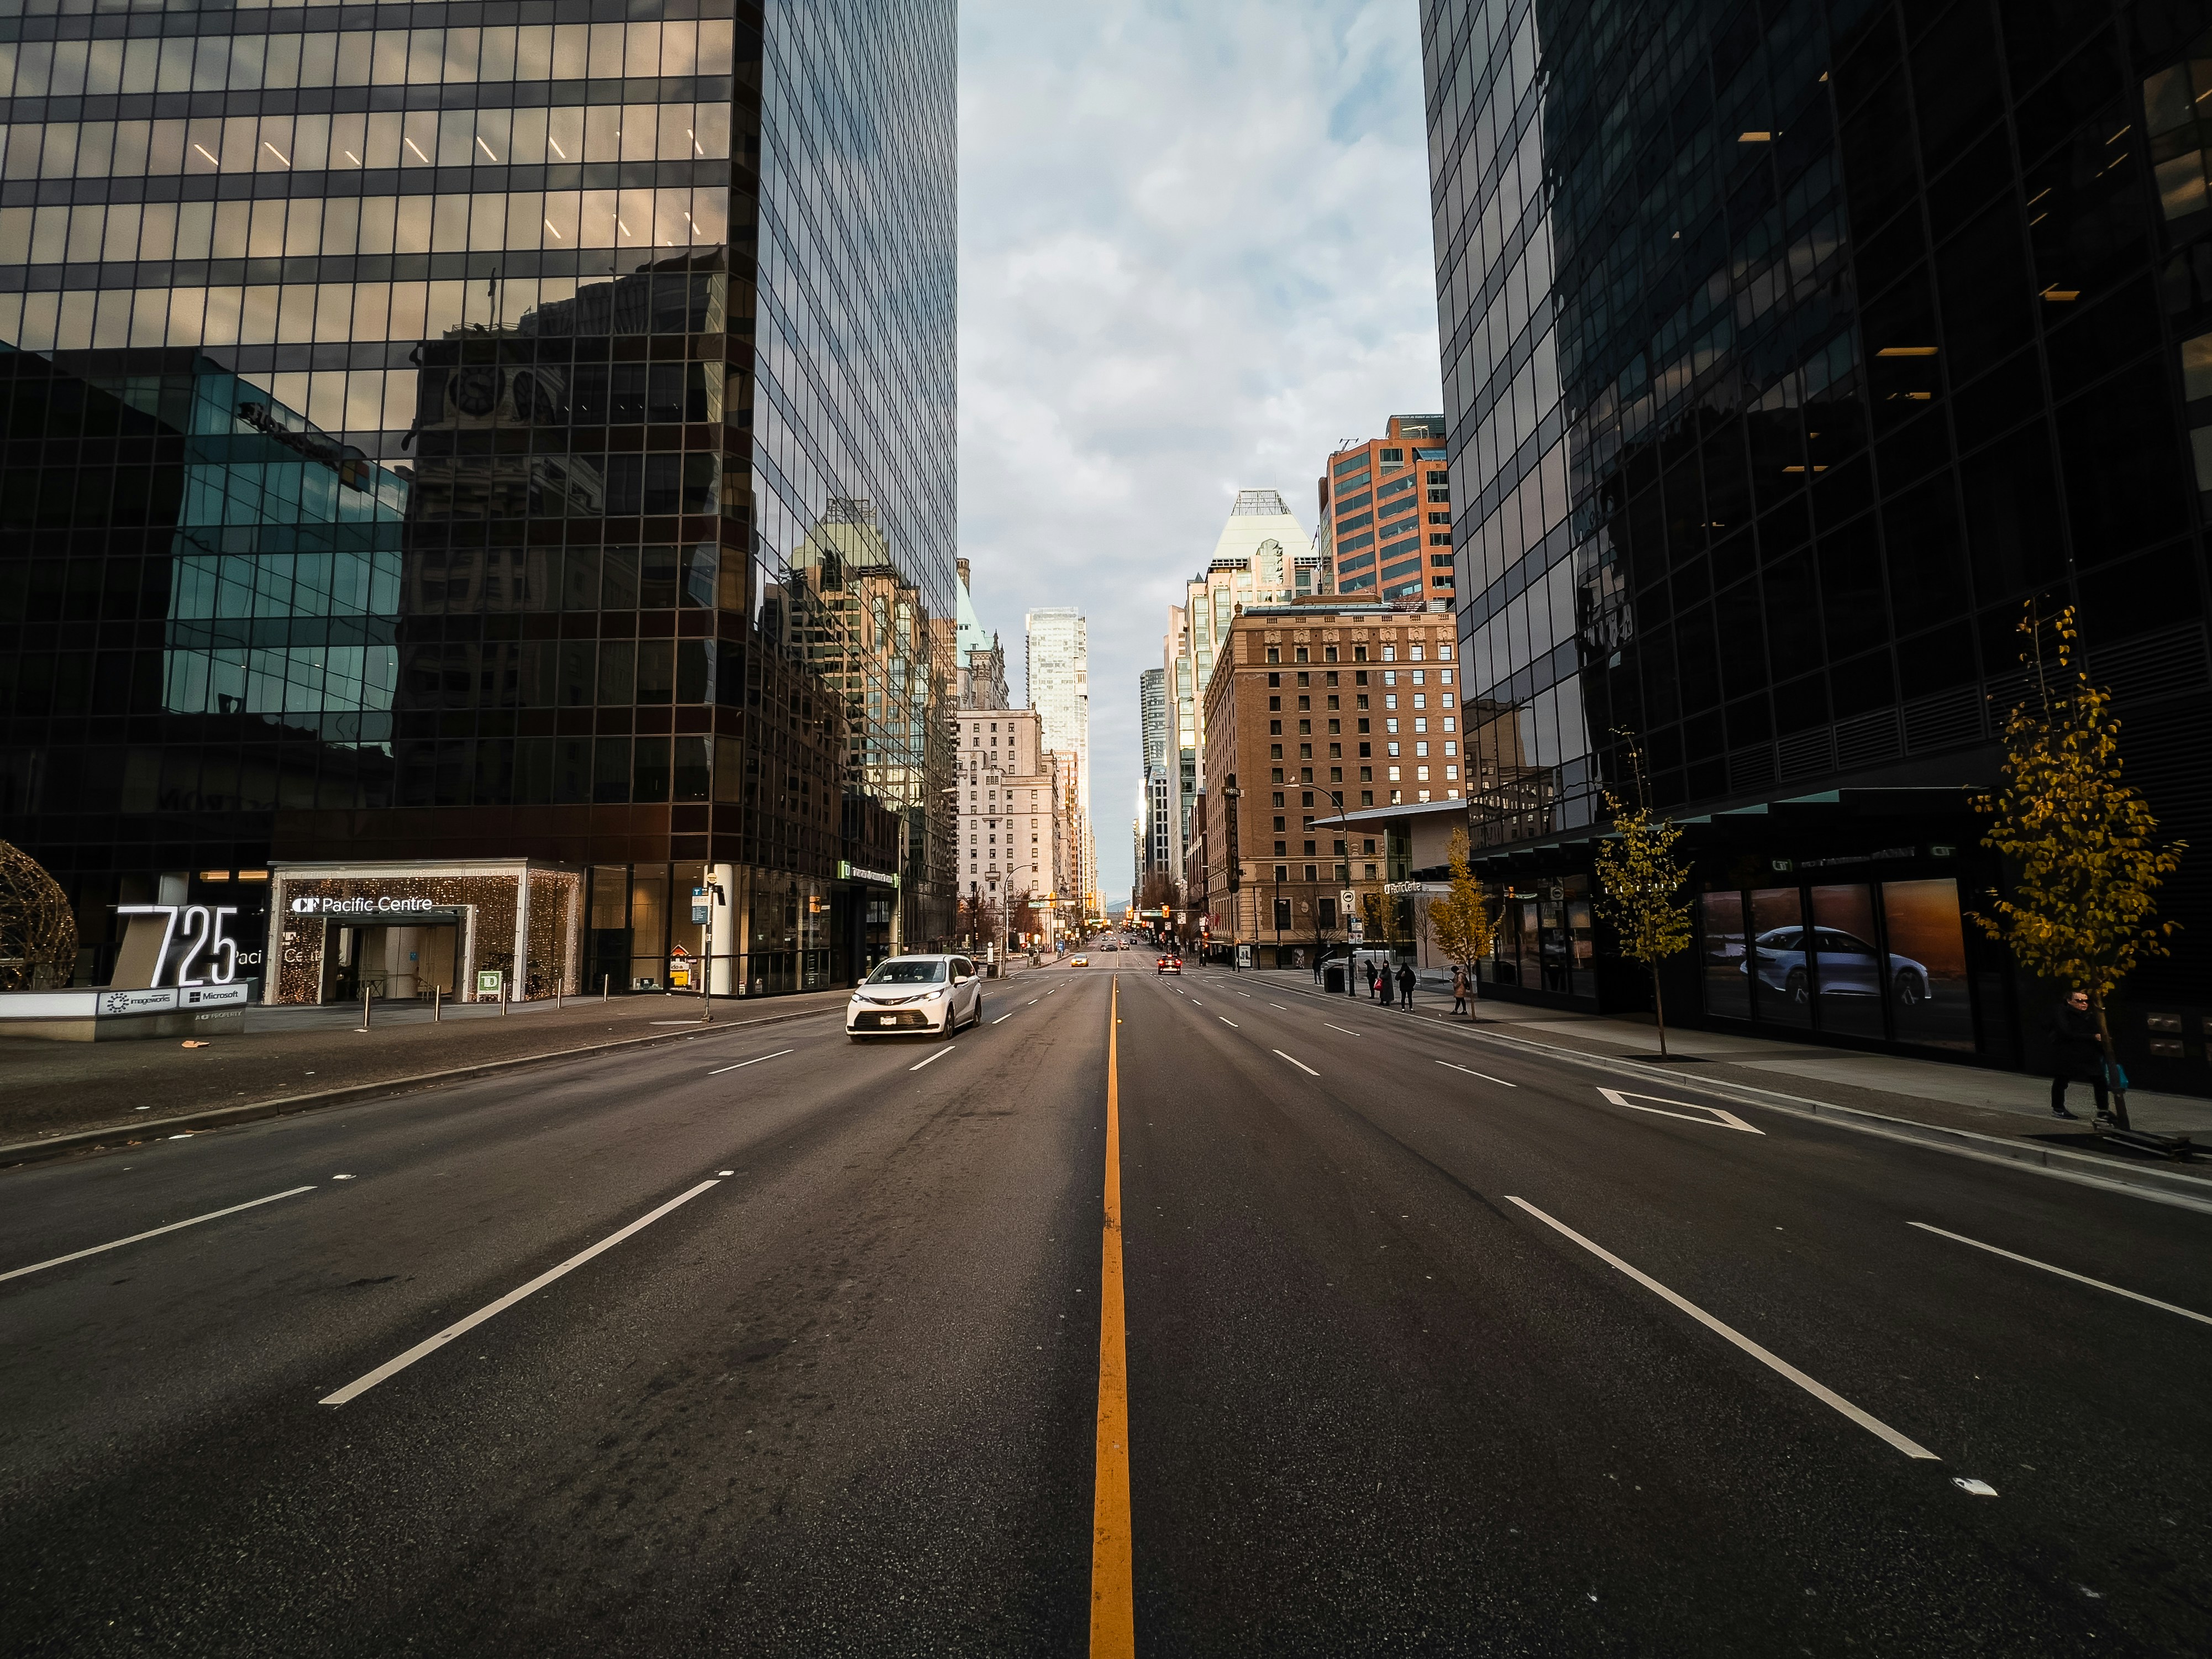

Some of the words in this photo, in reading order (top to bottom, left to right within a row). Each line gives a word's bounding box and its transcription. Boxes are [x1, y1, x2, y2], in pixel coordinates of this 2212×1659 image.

[322, 897, 374, 912] Pacific
[378, 896, 433, 911] Centre
[117, 906, 237, 989] 725
[481, 976, 498, 988] TD
[203, 991, 238, 1000] Microsoft
